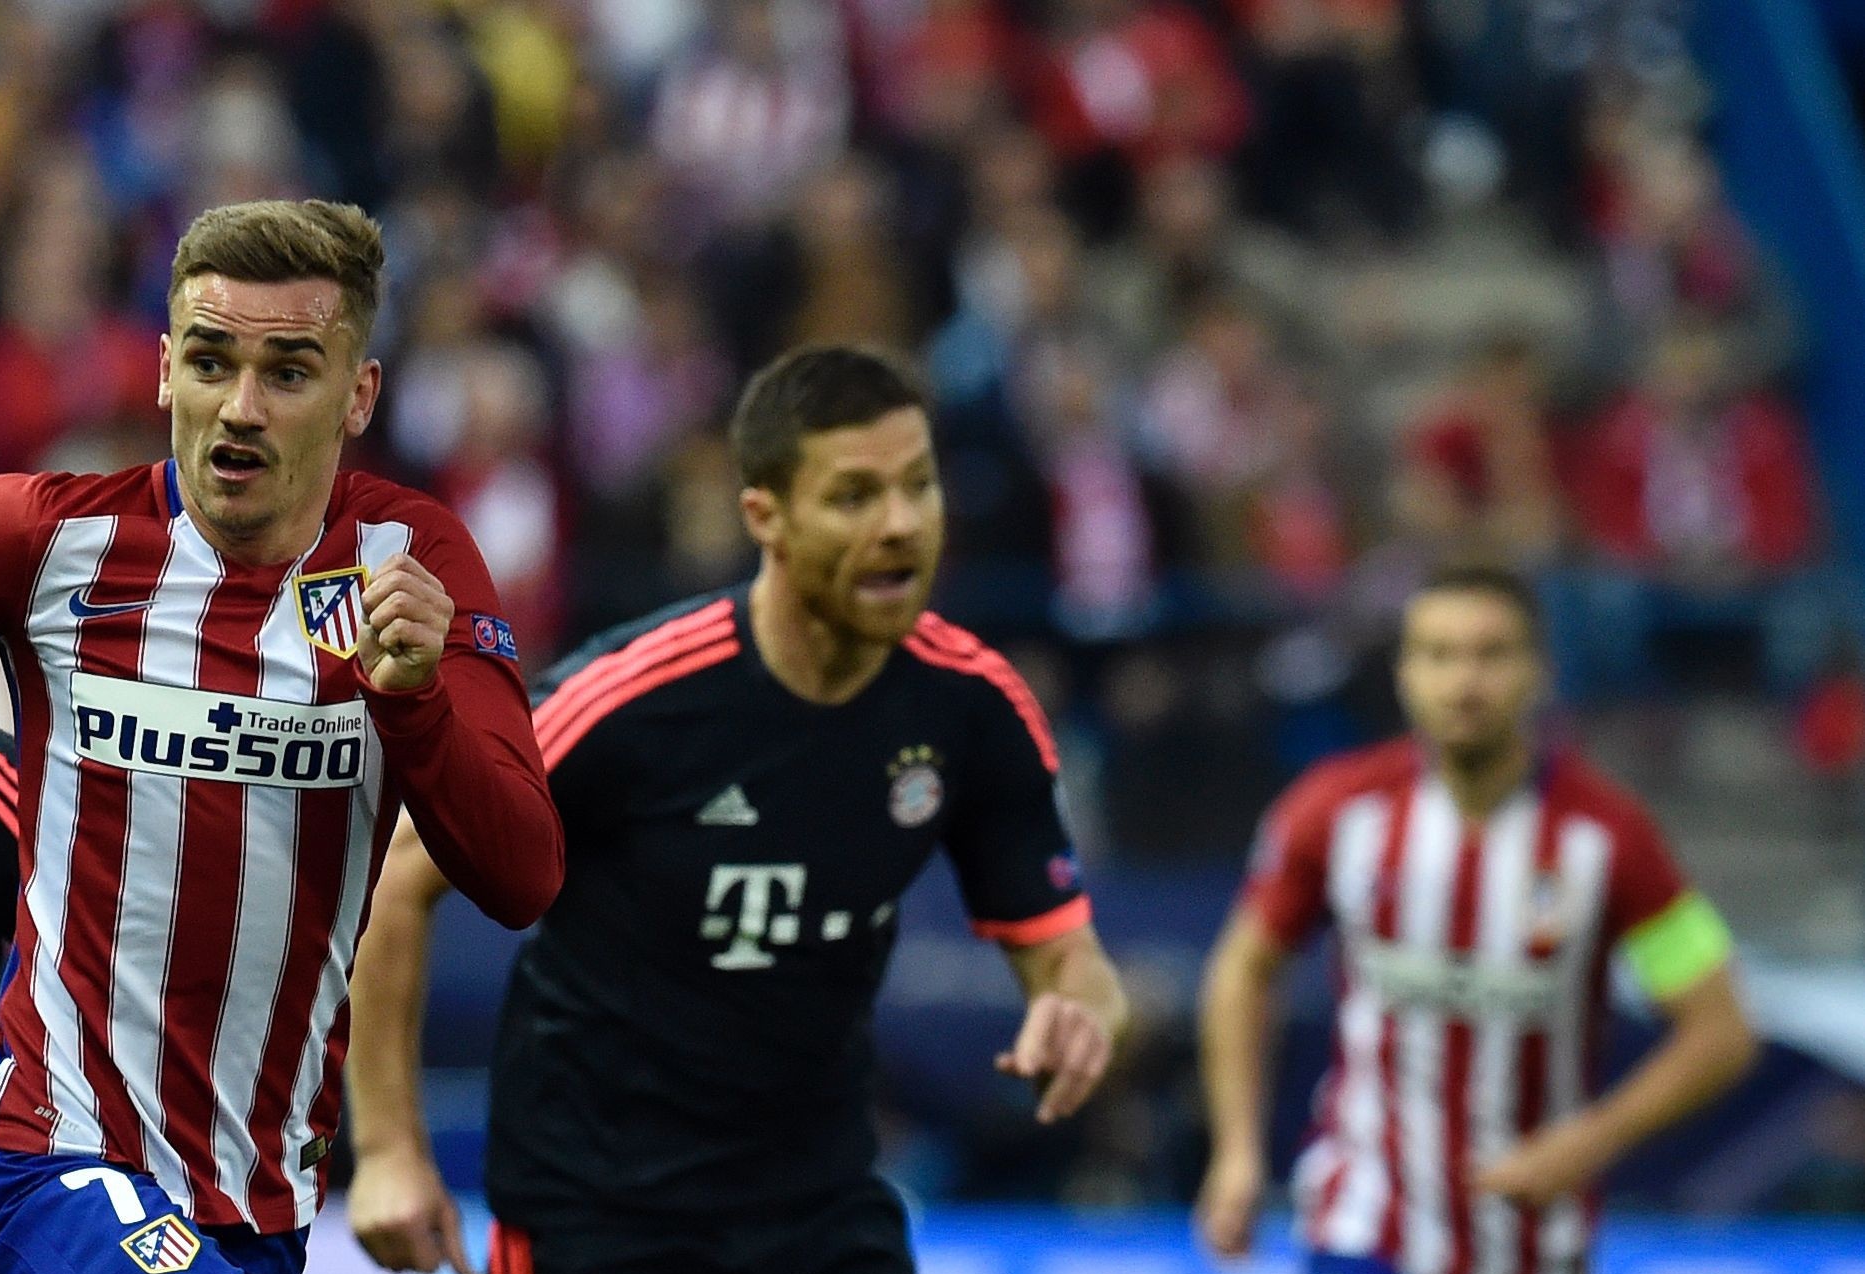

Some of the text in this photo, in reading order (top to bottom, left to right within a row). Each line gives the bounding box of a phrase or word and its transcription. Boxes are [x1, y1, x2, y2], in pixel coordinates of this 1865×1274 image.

[77, 704, 361, 782] Plus500
[247, 711, 362, 735] Trade Online
[60, 1167, 146, 1224] 7
